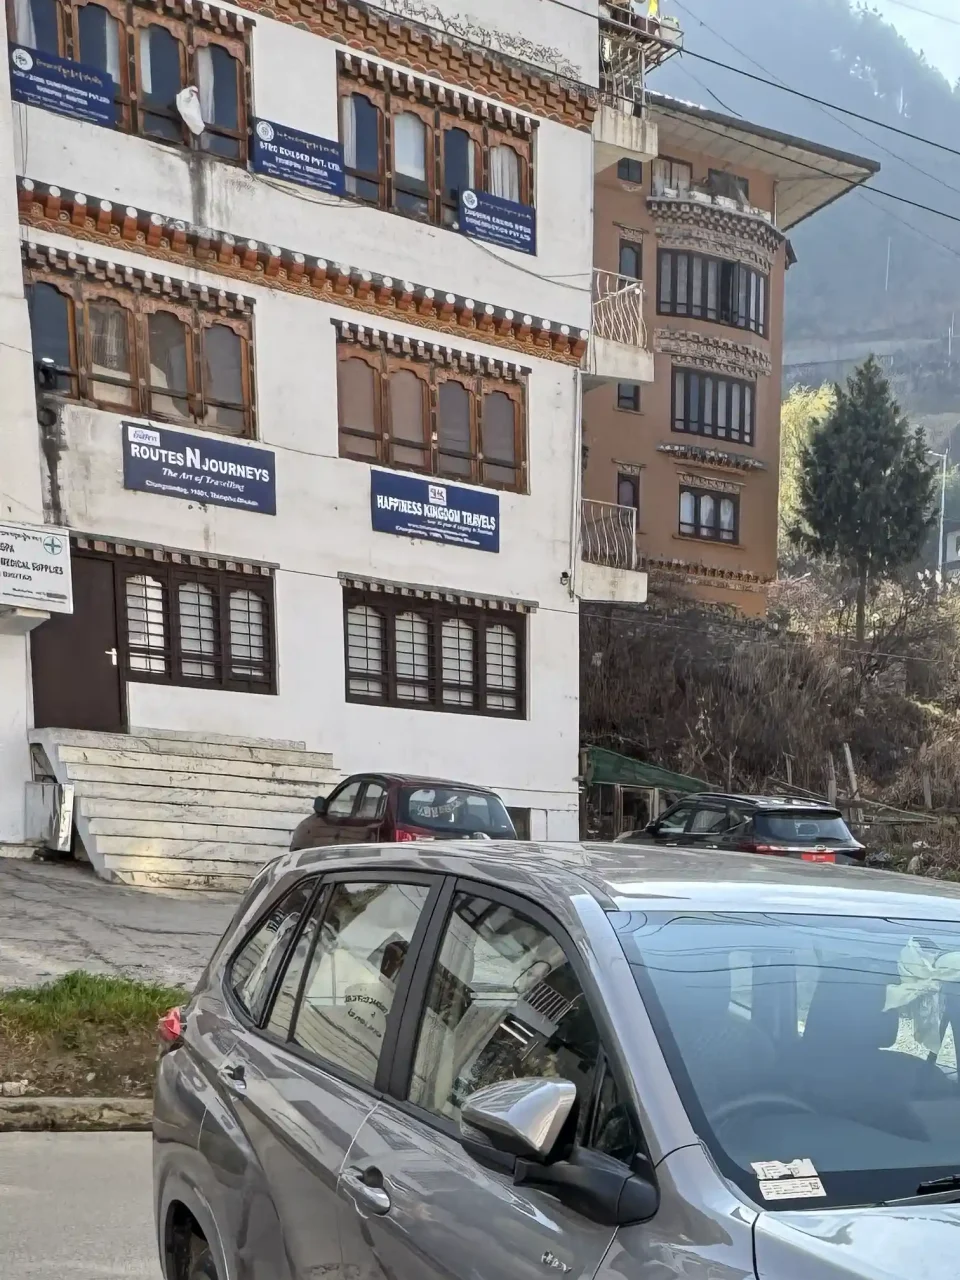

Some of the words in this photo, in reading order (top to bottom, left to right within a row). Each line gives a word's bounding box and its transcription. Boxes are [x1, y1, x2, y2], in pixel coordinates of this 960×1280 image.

[130, 443, 184, 466] ROUTES
[185, 446, 200, 469] N
[202, 457, 270, 482] JOURNEYS
[162, 467, 178, 478] The
[179, 472, 193, 481] Art
[194, 474, 204, 484] of
[376, 494, 422, 516] HAPPINESS
[423, 503, 461, 523] KINGDOM
[461, 511, 496, 531] TRAVELS
